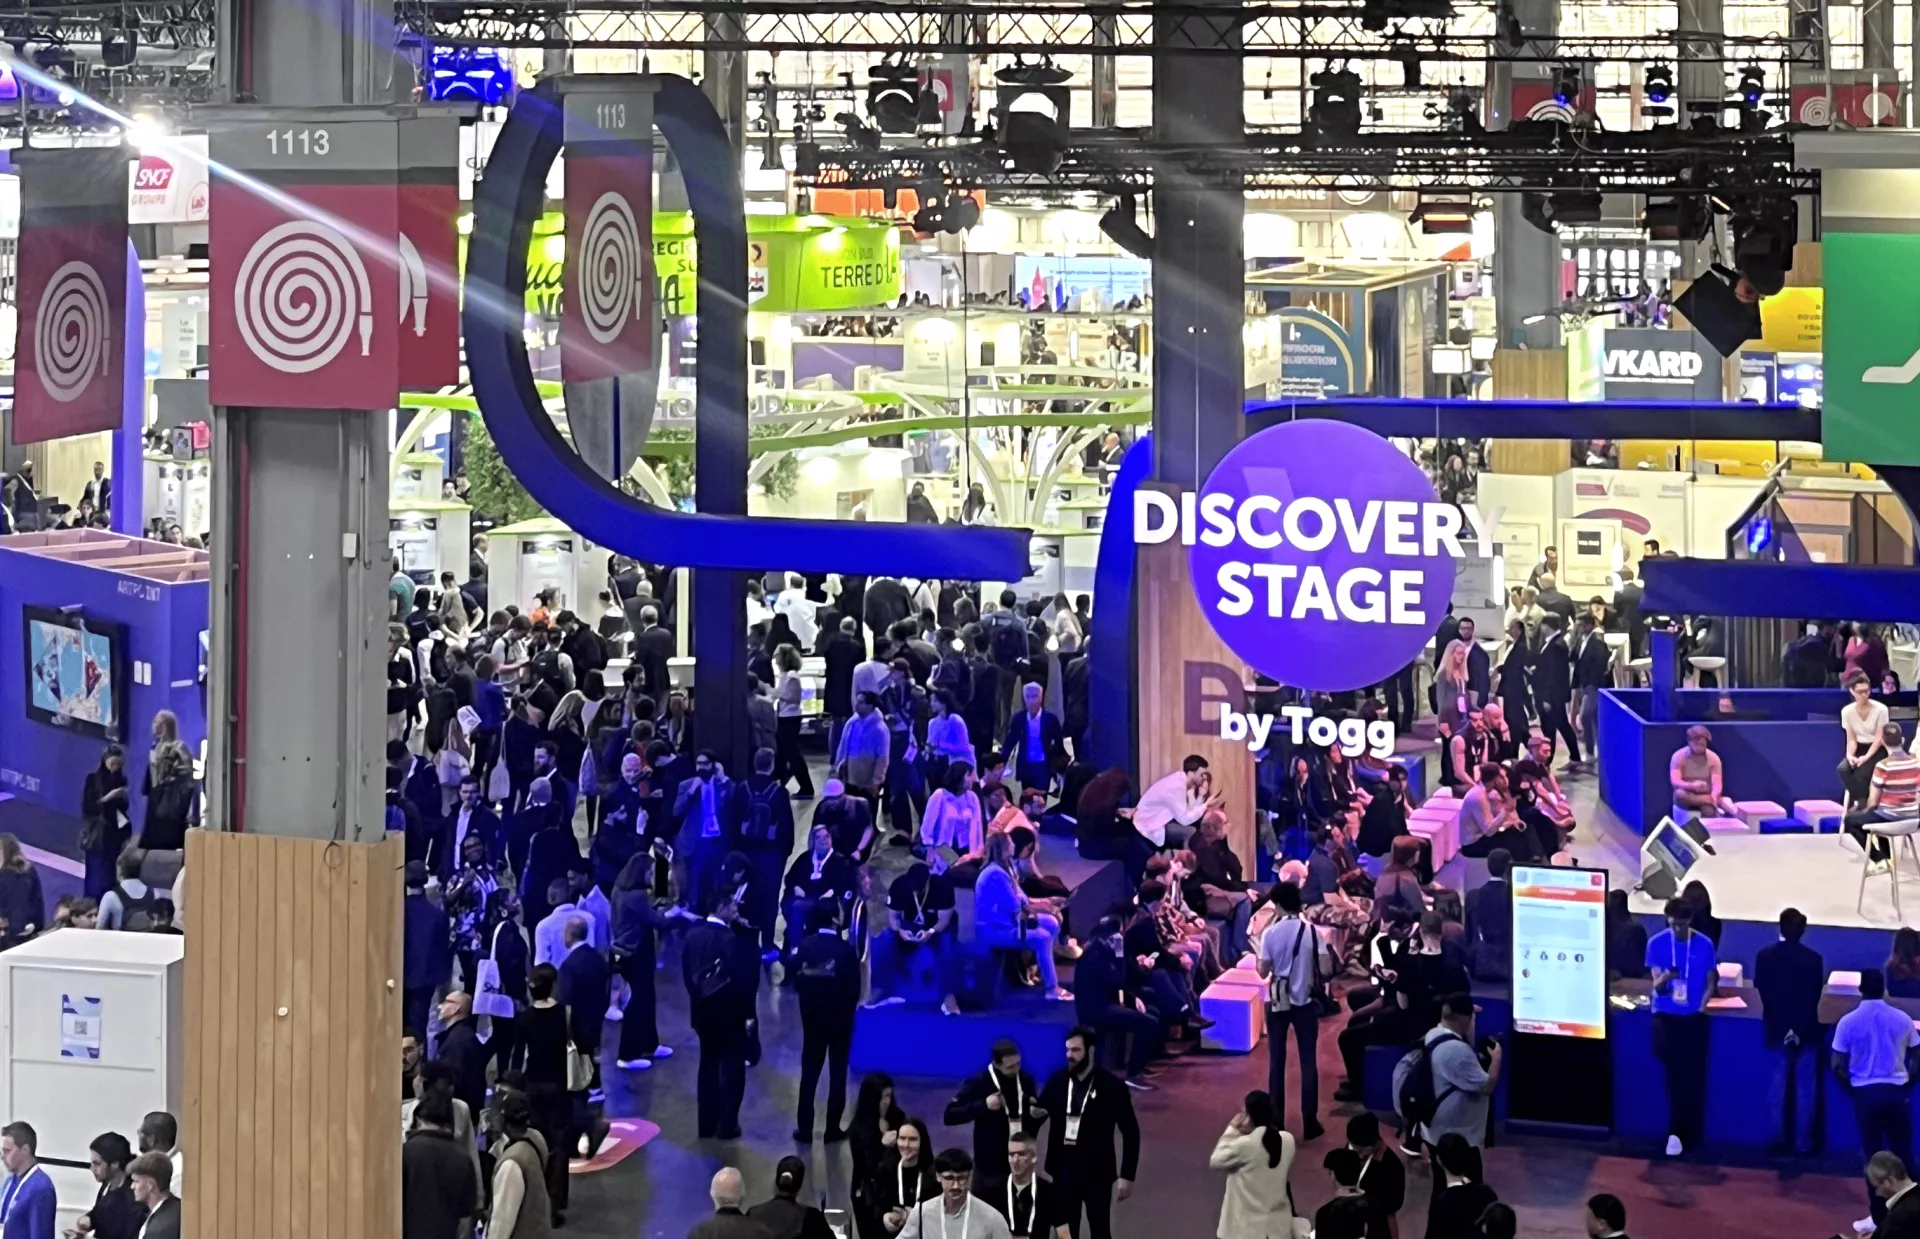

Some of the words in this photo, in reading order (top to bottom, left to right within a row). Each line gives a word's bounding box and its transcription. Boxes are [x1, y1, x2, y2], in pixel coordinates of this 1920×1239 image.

[596, 103, 626, 129] 1113
[266, 129, 330, 155] 1113
[136, 168, 171, 187] SNCF
[820, 263, 873, 289] TERRE
[1133, 489, 1507, 558] DISCOVERY
[1216, 561, 1426, 625] STAGE
[1220, 702, 1275, 751] by
[1281, 705, 1396, 759] Togg
